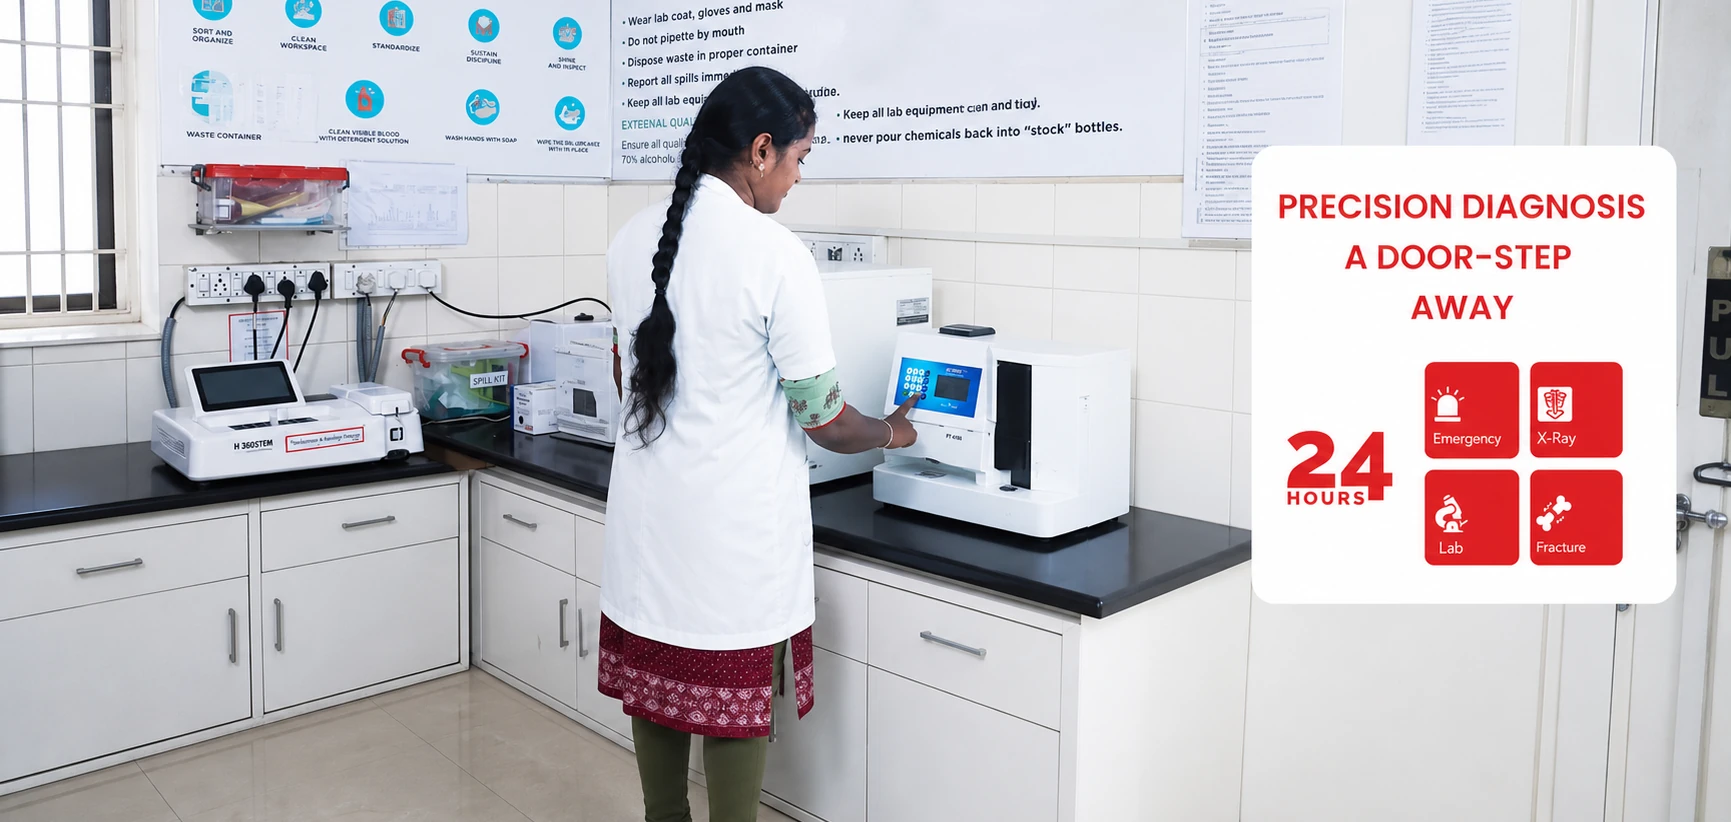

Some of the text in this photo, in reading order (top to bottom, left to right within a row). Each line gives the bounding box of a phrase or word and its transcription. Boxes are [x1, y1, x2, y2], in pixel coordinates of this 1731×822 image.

[628, 0, 783, 26] Wear lab coat, gloves and mask
[192, 28, 233, 37] SORT AND
[628, 25, 745, 47] Do not pipette by mouth
[192, 35, 234, 45] ORGANIZE
[291, 35, 316, 43] CLEAN
[280, 42, 327, 52] WORKSPACE
[372, 42, 420, 52] STANDARDIZE
[470, 50, 498, 58] SUSTAIN
[628, 43, 798, 68] Dispose waste in proper container
[466, 56, 501, 65] DISCIPLINE
[628, 69, 739, 89] Report all spills imme
[628, 97, 650, 109] Keep
[652, 96, 663, 106] all
[665, 95, 680, 106] lab
[843, 108, 870, 121] Keep
[872, 106, 885, 118] all
[887, 105, 903, 118] lab
[905, 102, 965, 118] equipment
[991, 99, 1012, 111] and
[621, 117, 696, 130] EXTEENAL QUAL
[186, 131, 262, 141] WASTE CONTAINER
[328, 128, 351, 136] CLEAN
[352, 129, 376, 137] VISIBLE
[843, 131, 873, 144] never
[876, 131, 902, 145] pour
[904, 127, 962, 141] chemicals
[964, 125, 993, 138] back
[996, 125, 1021, 137] into
[1075, 119, 1124, 134] bottles.
[338, 136, 375, 144] DETERGENT
[621, 140, 649, 150] Ensure
[651, 139, 661, 149] all
[621, 155, 638, 164] 70%
[473, 374, 506, 385] SPILL KIT
[233, 442, 240, 450] H
